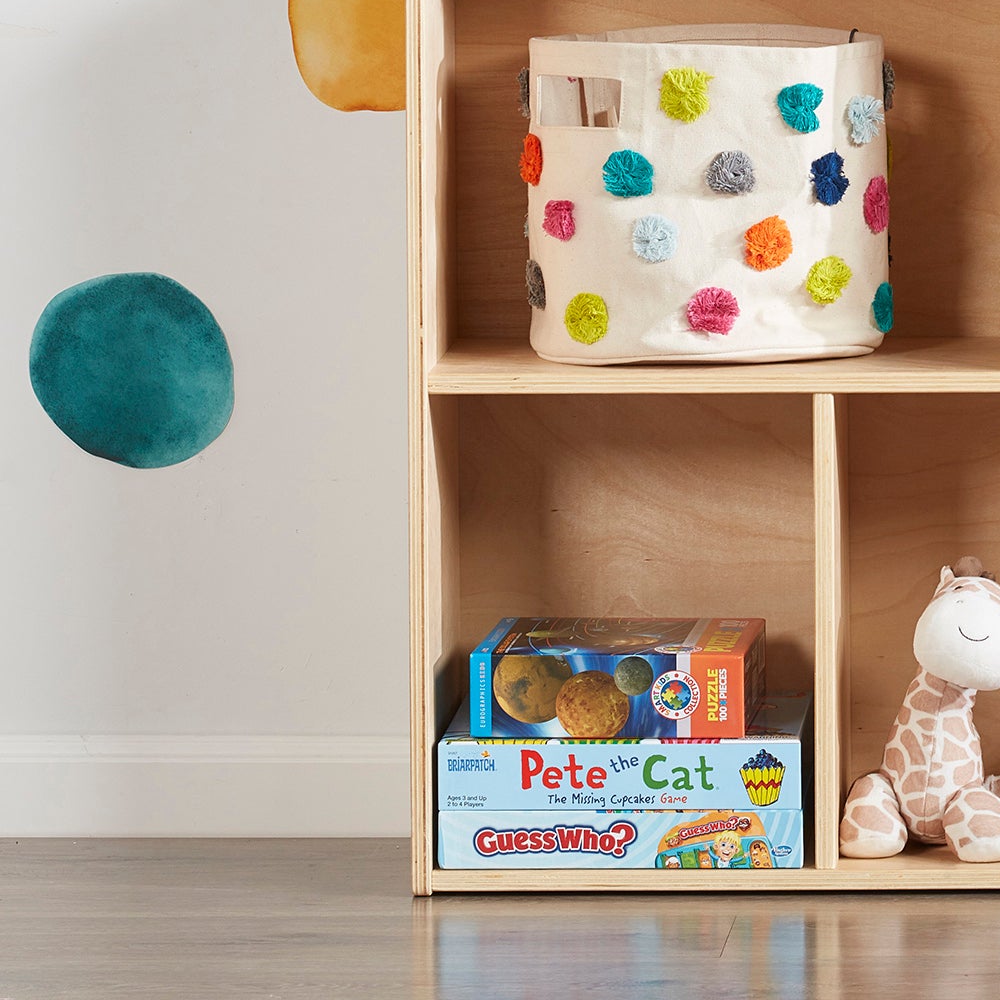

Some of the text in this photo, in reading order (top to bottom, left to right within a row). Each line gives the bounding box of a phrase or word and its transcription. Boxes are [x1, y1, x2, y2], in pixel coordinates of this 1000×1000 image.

[653, 674, 670, 716] SMART KIDS
[682, 675, 699, 715] COLLECTION
[707, 668, 719, 721] PUZZLE
[719, 668, 727, 722] 100 PIECES
[520, 749, 715, 791] Pete the Cat
[548, 792, 688, 807] The Missing Cupcakes Game
